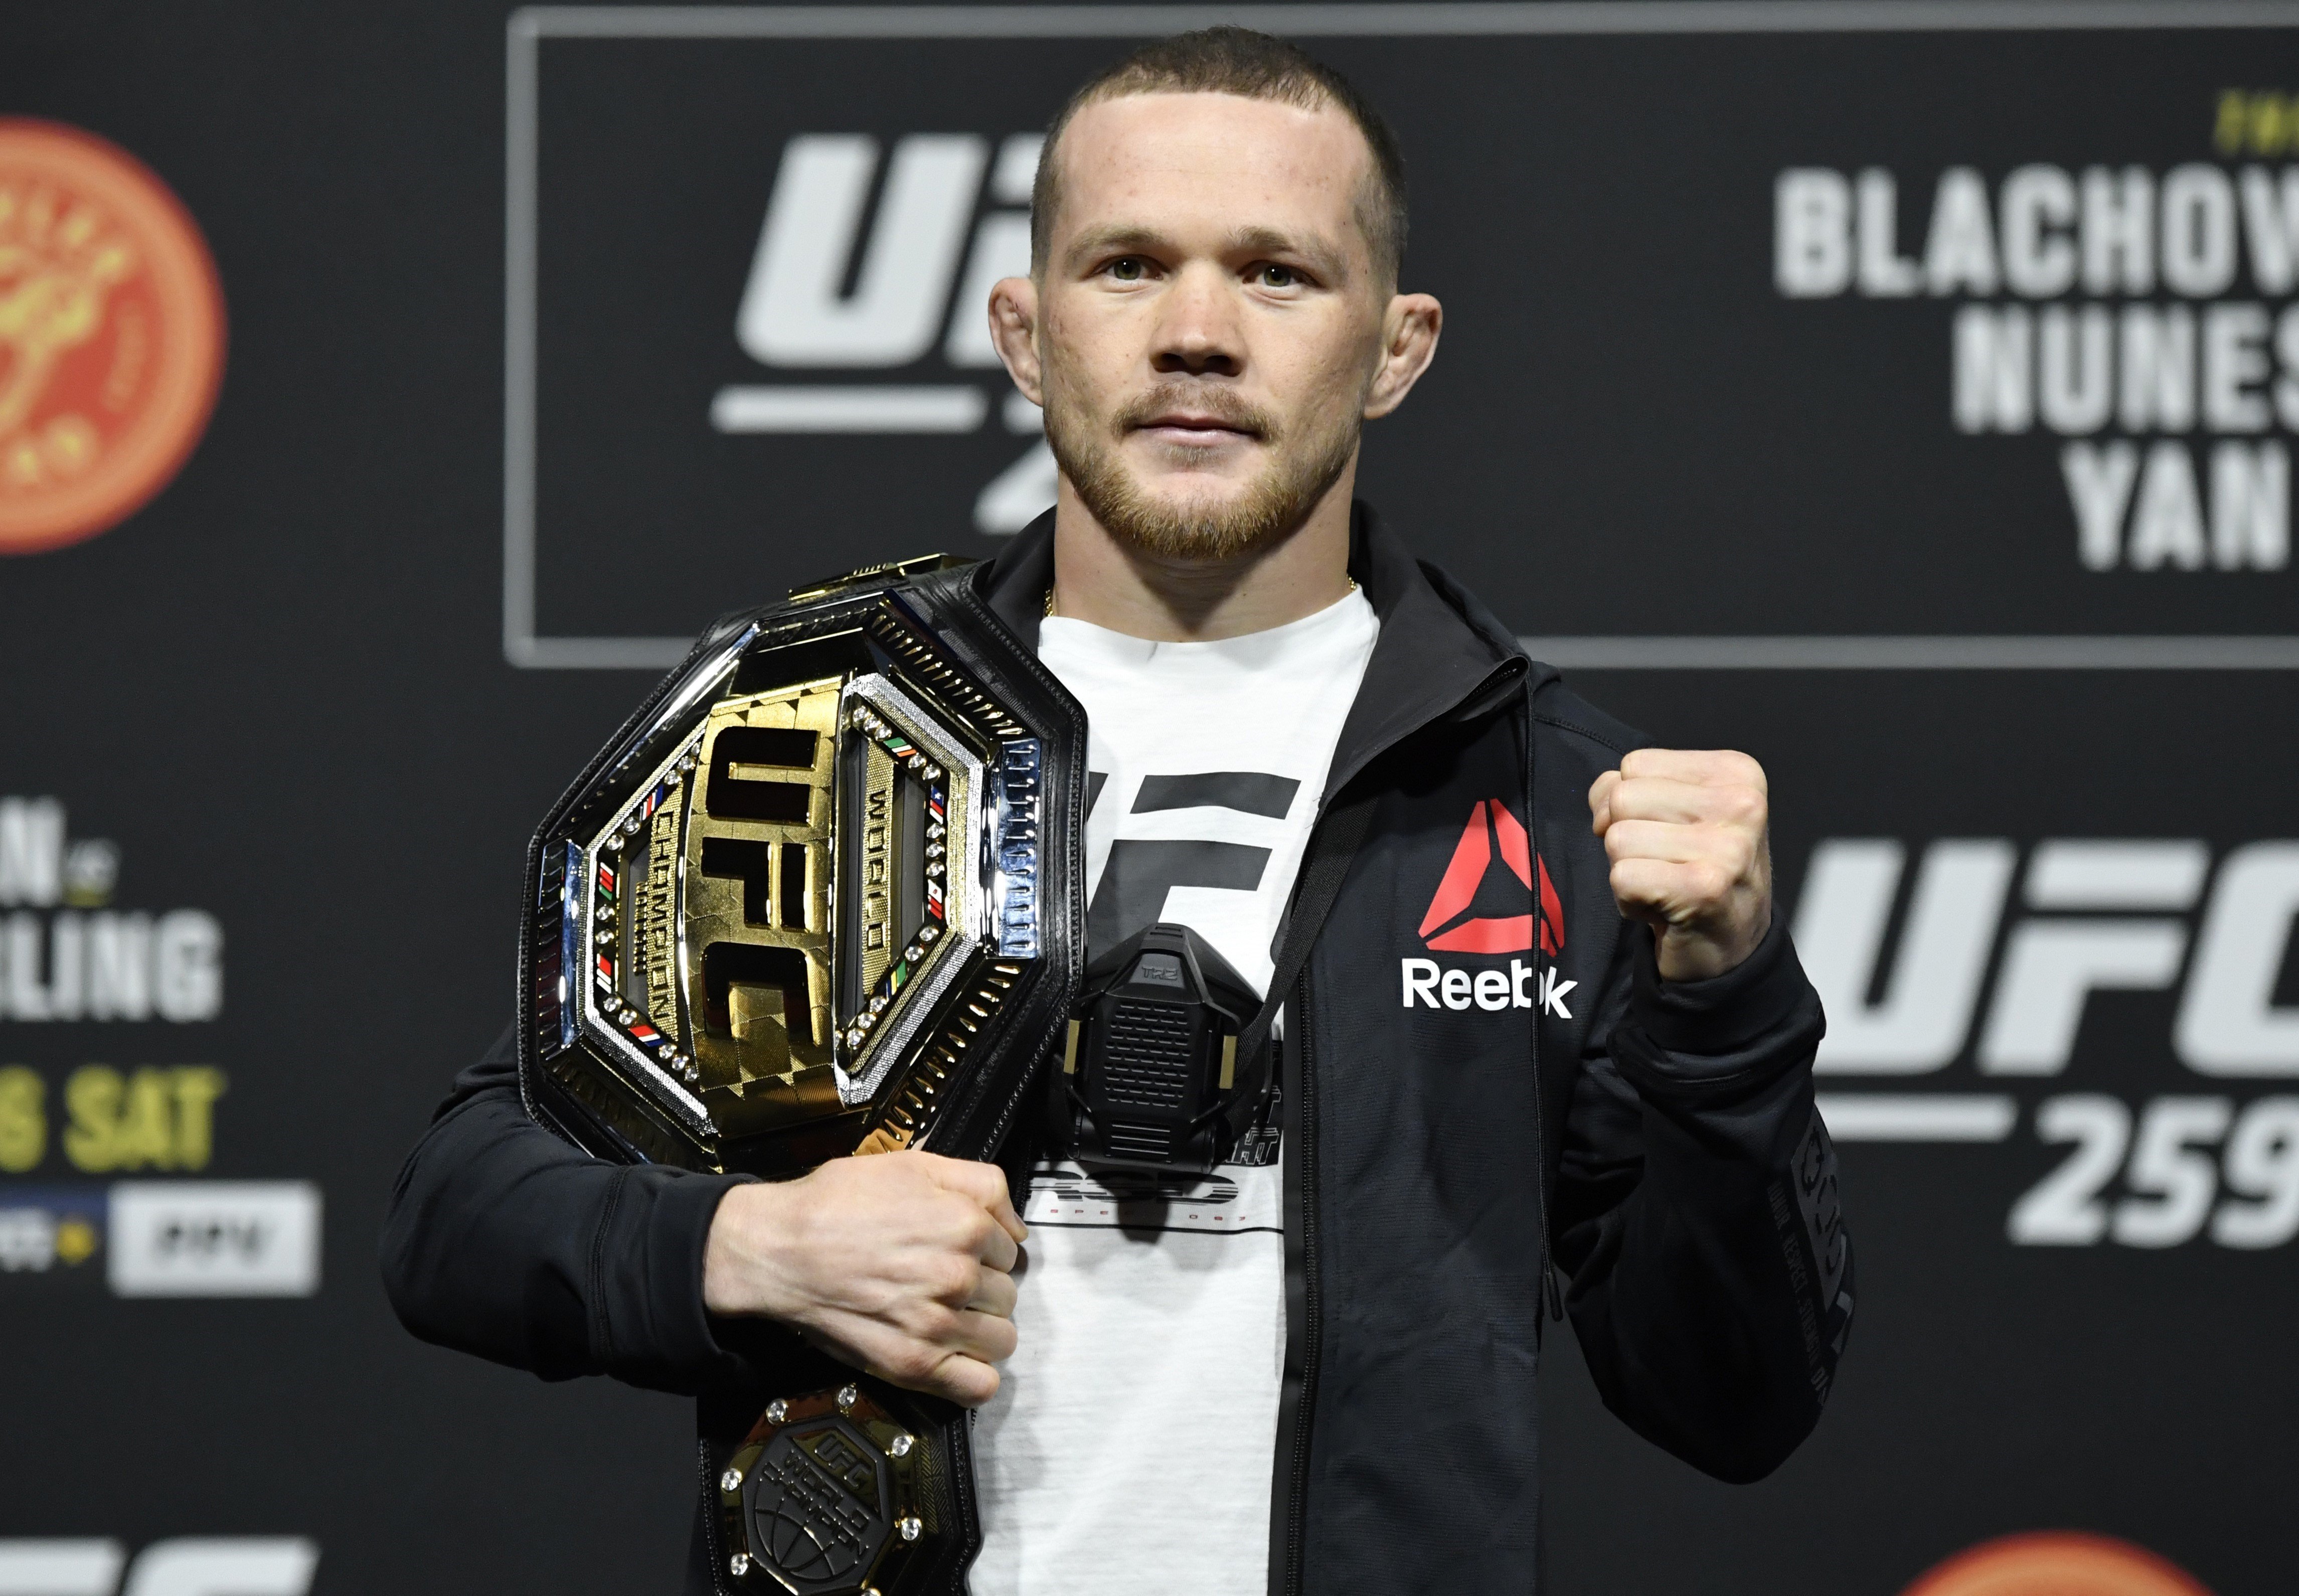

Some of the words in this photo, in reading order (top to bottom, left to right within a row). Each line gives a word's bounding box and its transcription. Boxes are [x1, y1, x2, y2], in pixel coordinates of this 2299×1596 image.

[2062, 440, 2290, 570] YAN
[650, 811, 675, 1020] CHAMPION
[702, 725, 823, 1047] UFC
[867, 789, 888, 952] WORLD
[0, 910, 222, 1022] LING
[1401, 958, 1578, 1019] Reebk
[1790, 839, 2299, 1077] UFC
[63, 1068, 224, 1171] SAT
[2008, 1095, 2299, 1248] 259
[784, 1450, 870, 1532] WORLD
[814, 1433, 872, 1491] UFC
